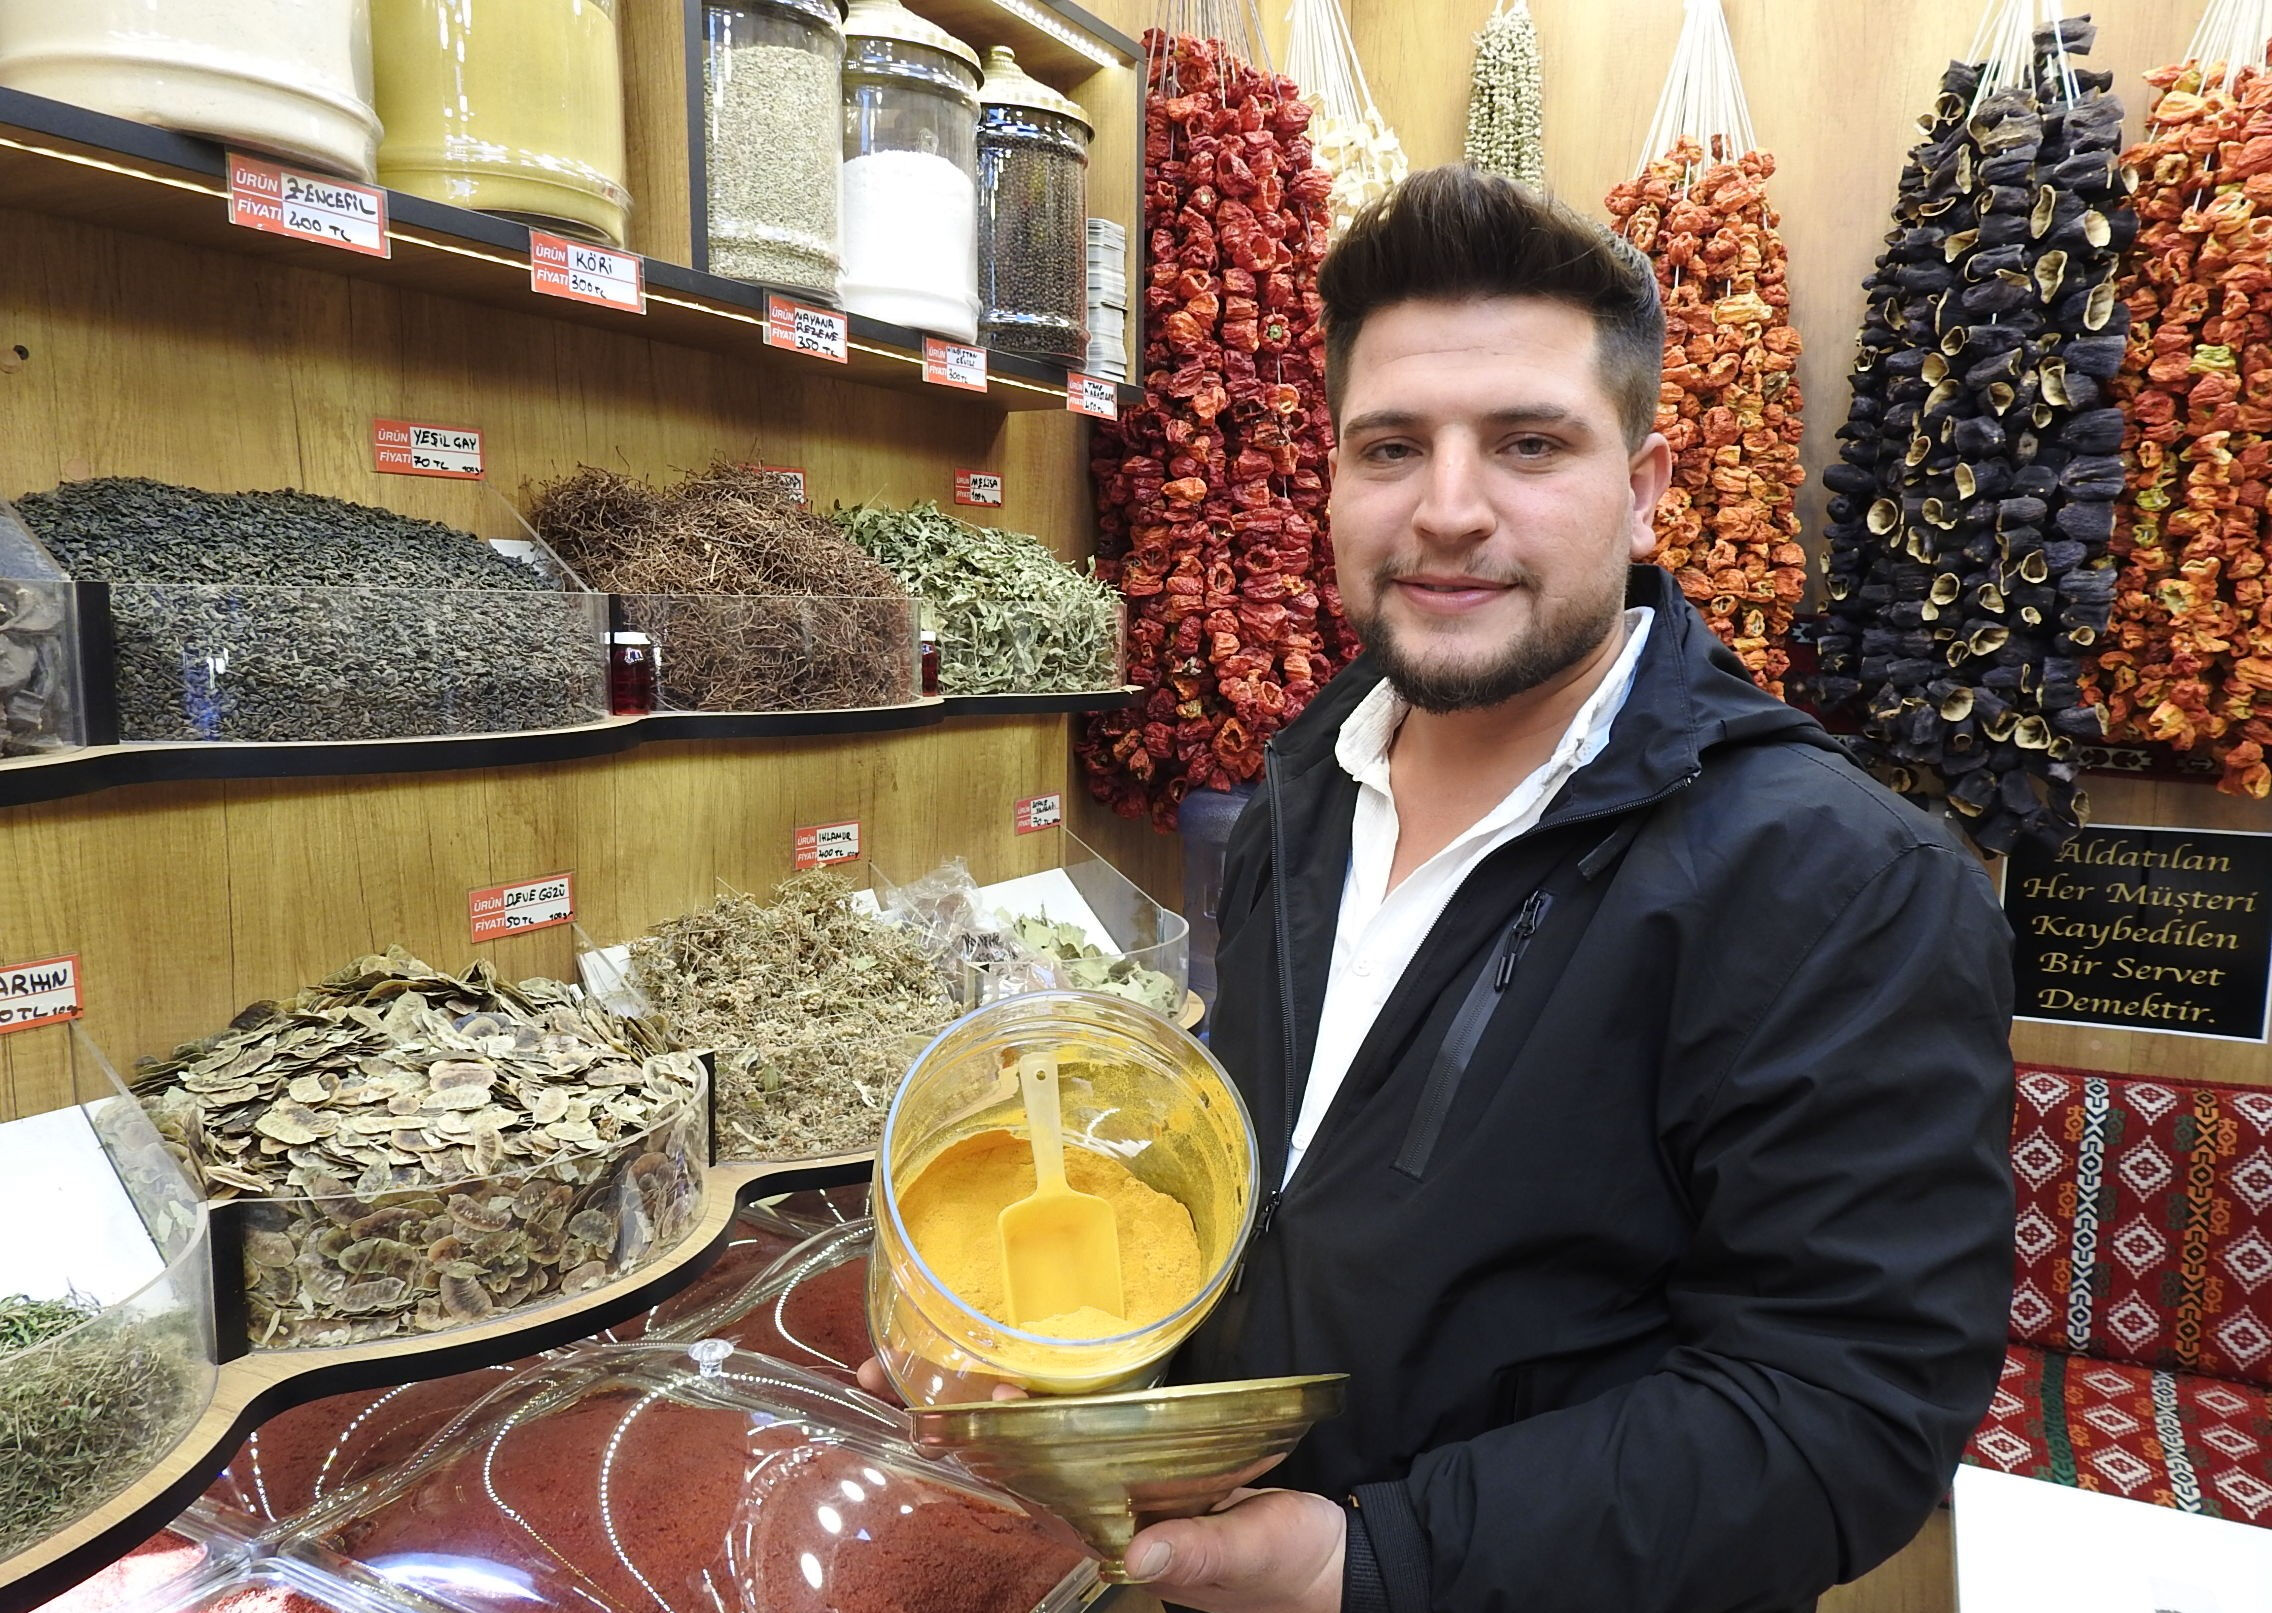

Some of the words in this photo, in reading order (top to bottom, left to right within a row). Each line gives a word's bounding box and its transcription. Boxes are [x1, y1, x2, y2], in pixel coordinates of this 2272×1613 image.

[236, 168, 278, 192] ÜRÜN
[238, 198, 283, 221] FİYATI
[289, 211, 322, 232] 400
[328, 225, 352, 242] TL
[535, 244, 566, 262] ÜRÜN
[537, 268, 568, 286] FİYATI
[771, 306, 794, 321] ÜRÜN
[796, 322, 839, 341] REZENE
[771, 326, 795, 341] FİYATI
[797, 336, 819, 351] 350
[822, 346, 839, 358] TL
[378, 429, 408, 443] ÜRÜN
[379, 450, 411, 464] FİYATI
[413, 456, 430, 467] 70
[433, 460, 449, 469] TL
[797, 834, 816, 846] ÜRÜN
[798, 851, 817, 862] FİYATI
[2054, 838, 2232, 873] Aldatılan
[2023, 872, 2095, 900] Her
[2105, 882, 2259, 915] Müşteri
[473, 897, 502, 912] ÜRÜN
[475, 918, 505, 932] FİYATI
[2031, 915, 2240, 950] Kaybedilen
[2038, 952, 2103, 975] Bir
[2112, 957, 2226, 987] Servet
[2038, 988, 2216, 1023] Demektir.
